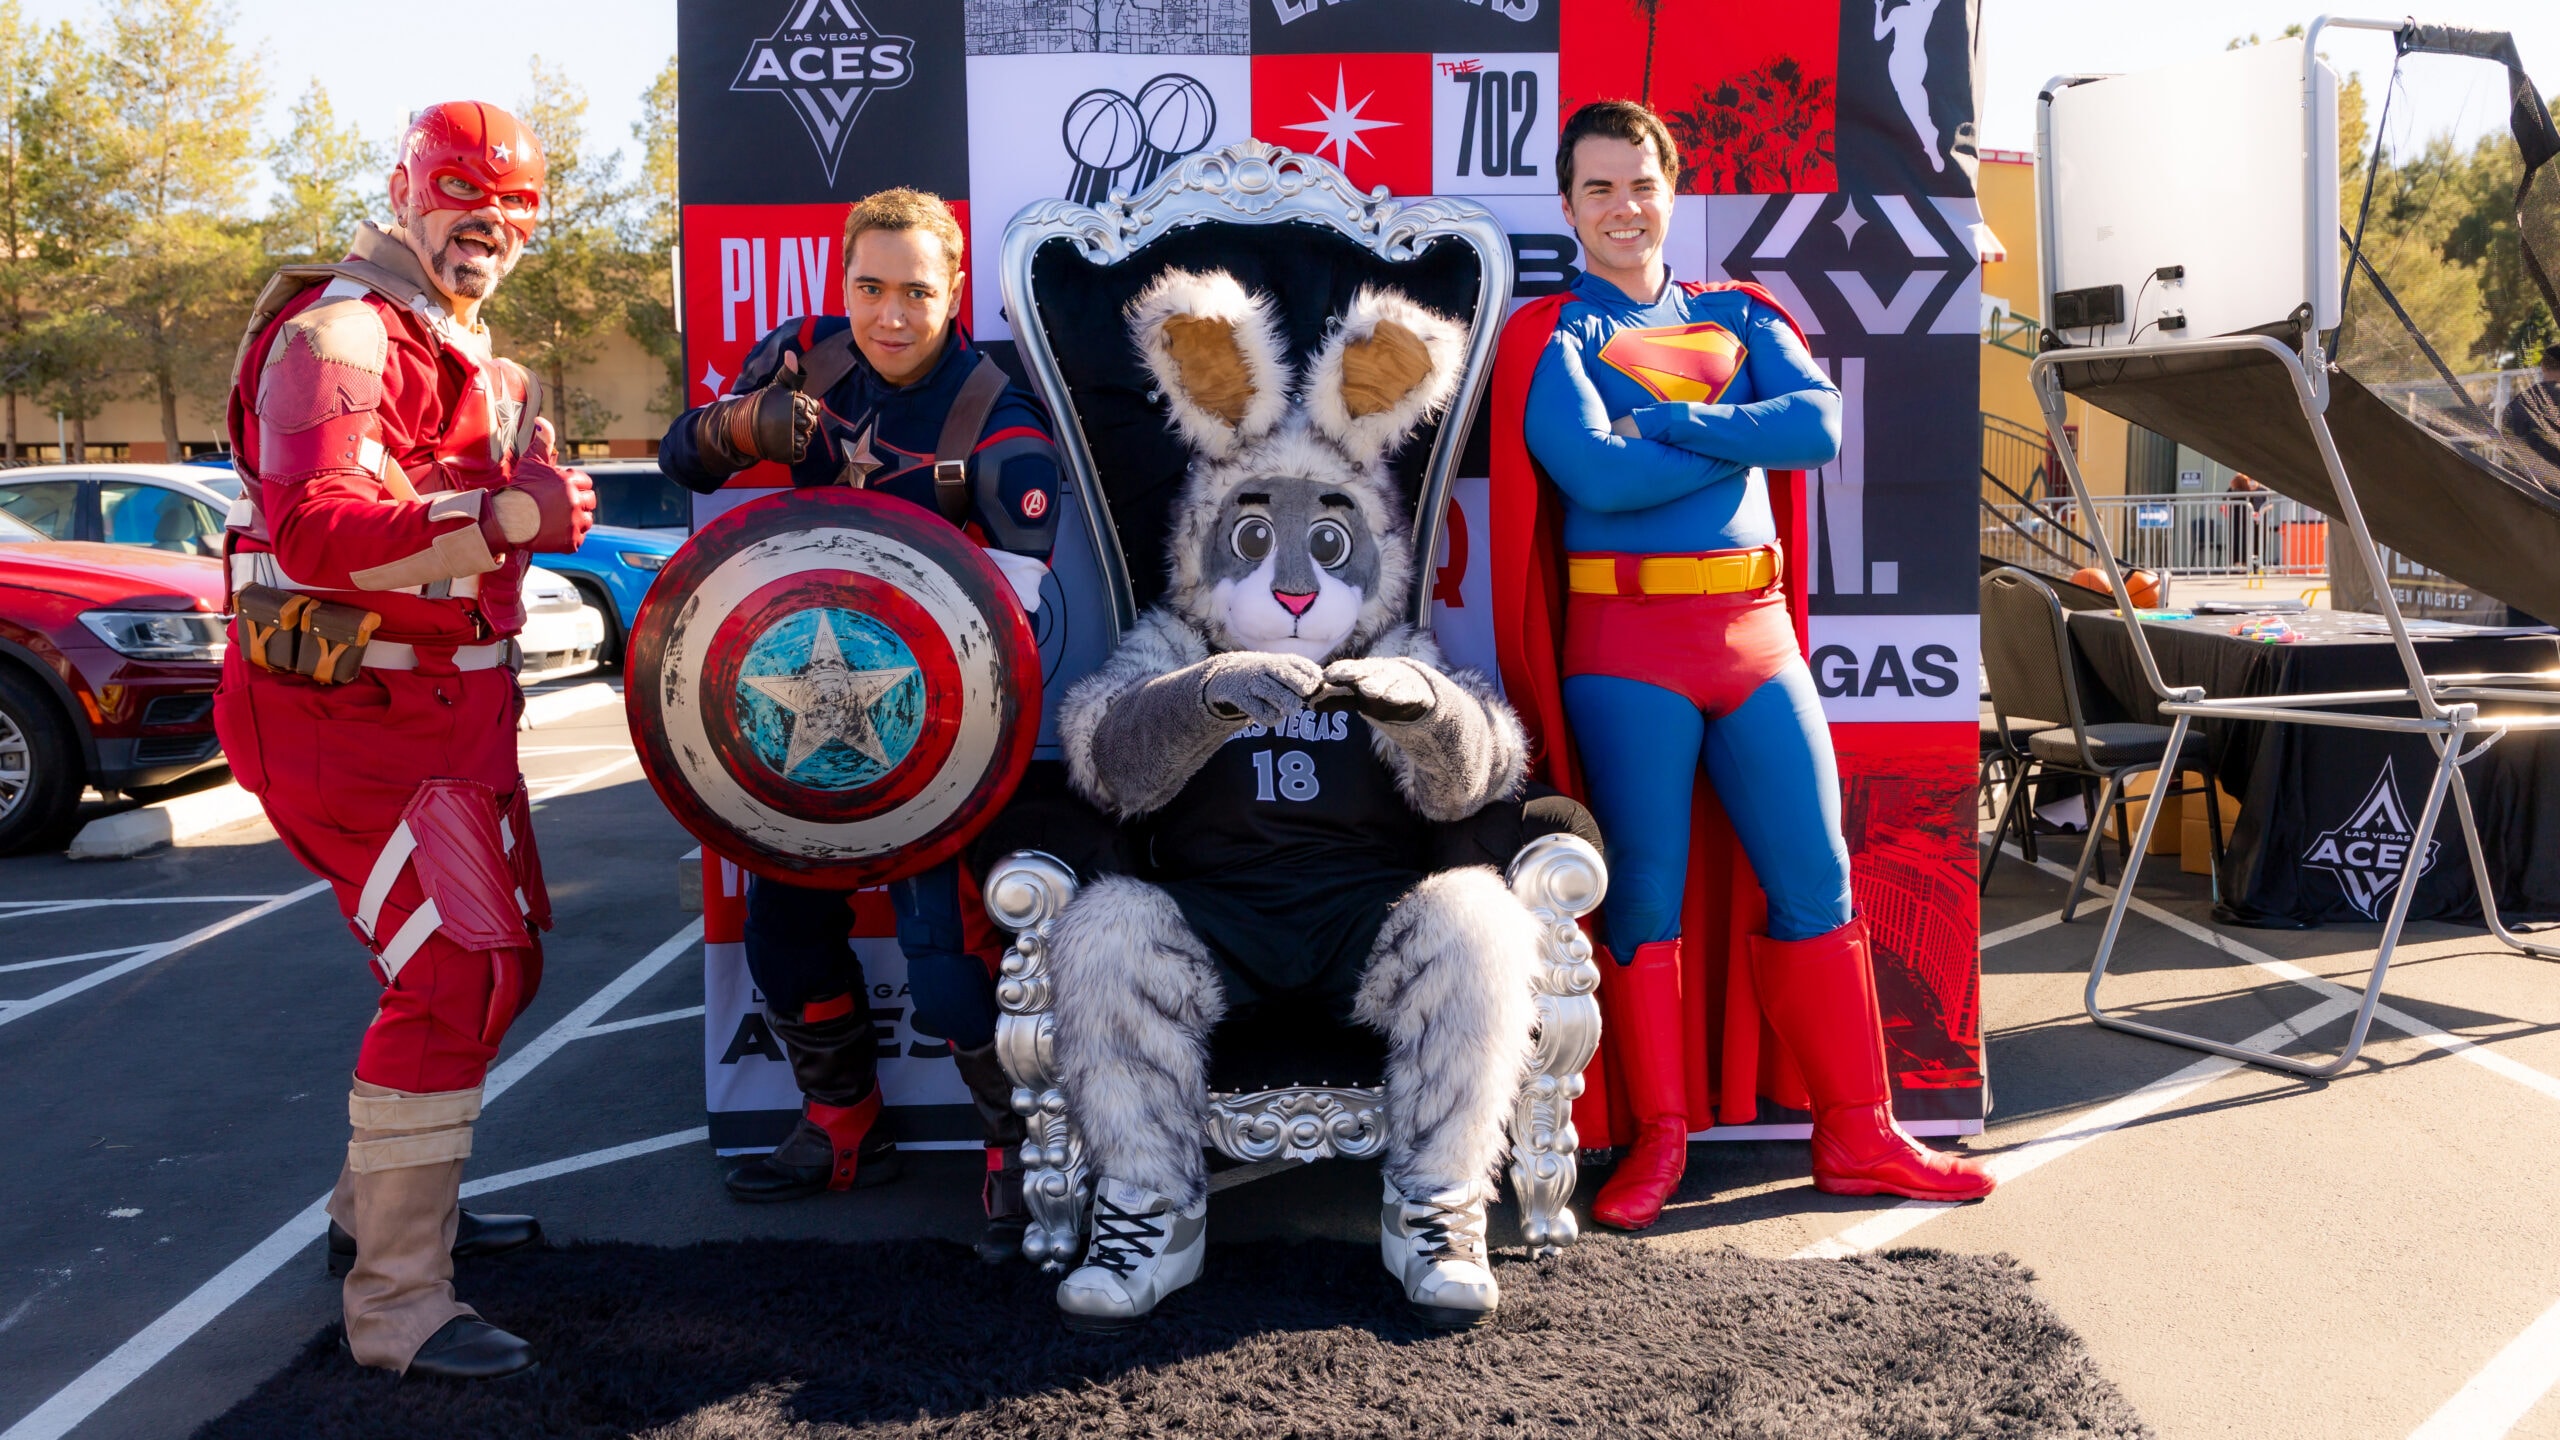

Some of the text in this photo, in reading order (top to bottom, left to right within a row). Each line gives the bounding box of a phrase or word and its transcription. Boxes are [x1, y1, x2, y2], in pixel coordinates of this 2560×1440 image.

[784, 32, 868, 42] LAS VEGAS
[747, 44, 905, 82] ACES
[1436, 58, 1484, 77] THE
[1453, 70, 1538, 177] 702
[720, 236, 830, 342] PLAY
[1810, 643, 1959, 698] GAS
[1252, 748, 1320, 801] 18
[2344, 830, 2412, 842] LAS VEGAS
